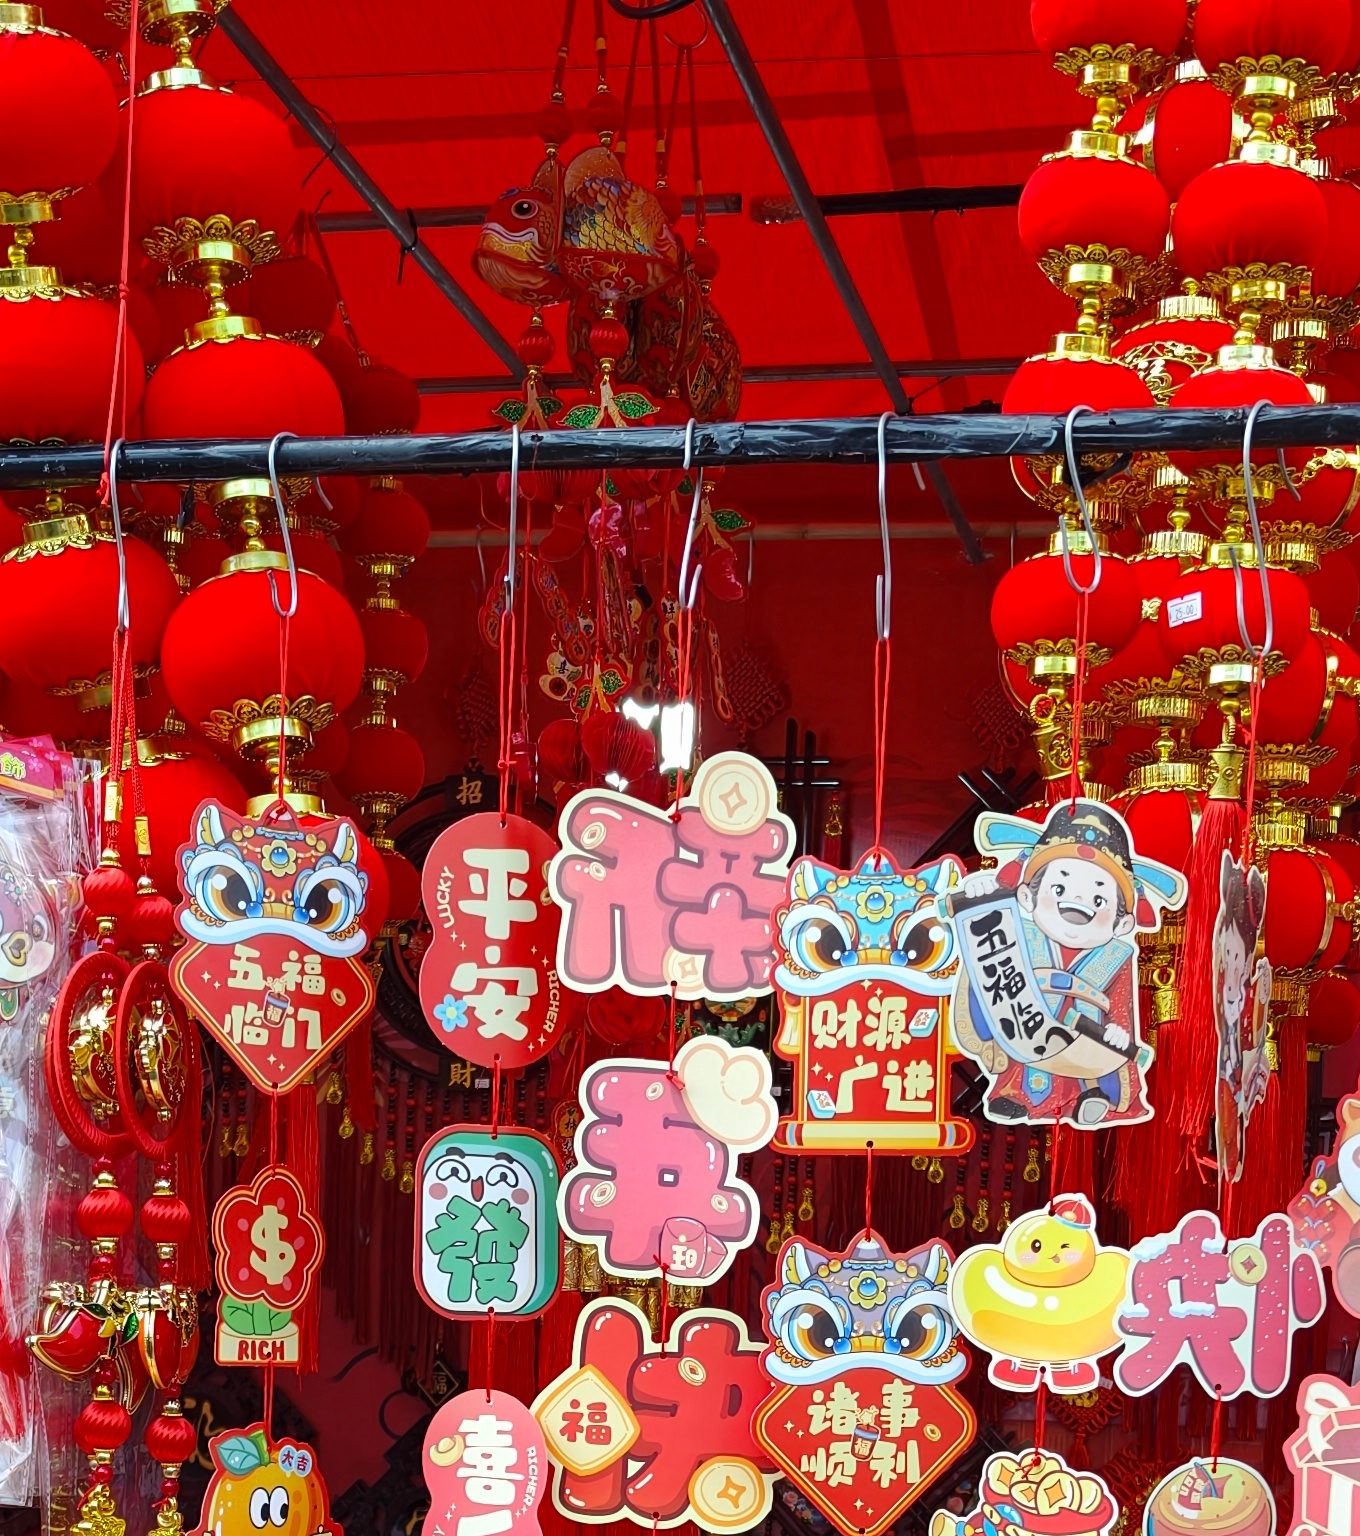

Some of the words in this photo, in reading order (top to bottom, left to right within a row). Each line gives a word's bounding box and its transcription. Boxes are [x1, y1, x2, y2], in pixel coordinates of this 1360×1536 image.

[455, 776, 484, 806] 招
[436, 865, 457, 928] LUCKY
[227, 945, 326, 995] 五福
[451, 848, 538, 1041] 平安
[221, 1001, 323, 1051] 临门
[541, 968, 561, 1036] RICHER
[811, 997, 911, 1051] 财源
[836, 1058, 934, 1113] 广进
[426, 1196, 529, 1304] 發
[236, 1333, 286, 1362] RICH
[561, 1400, 611, 1446] 福
[807, 1379, 919, 1437] 诸事
[522, 1446, 538, 1510] RICHER
[801, 1440, 922, 1489] 顺利
